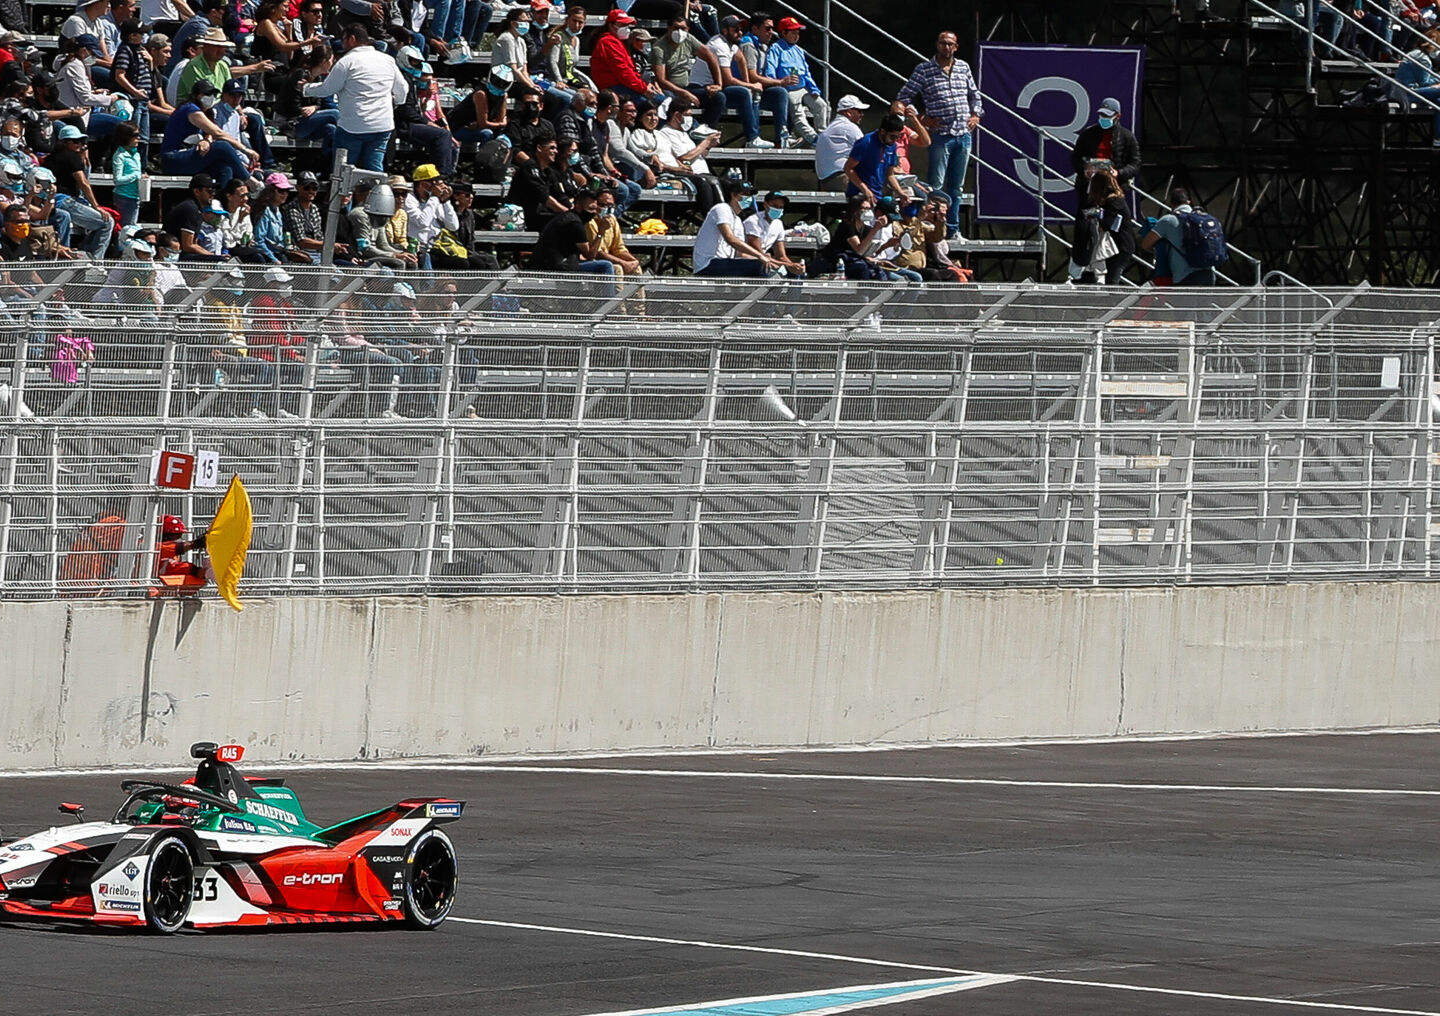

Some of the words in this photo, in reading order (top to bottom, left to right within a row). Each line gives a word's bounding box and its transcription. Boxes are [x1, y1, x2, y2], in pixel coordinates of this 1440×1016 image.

[1013, 76, 1090, 193] 3
[165, 457, 186, 483] F
[202, 459, 213, 479] 15
[221, 747, 238, 760] RAS
[245, 800, 300, 826] SCHAEFFLER
[390, 828, 412, 837] SONAX
[283, 872, 343, 885] e-tron
[109, 885, 130, 896] riello
[193, 877, 218, 901] 33
